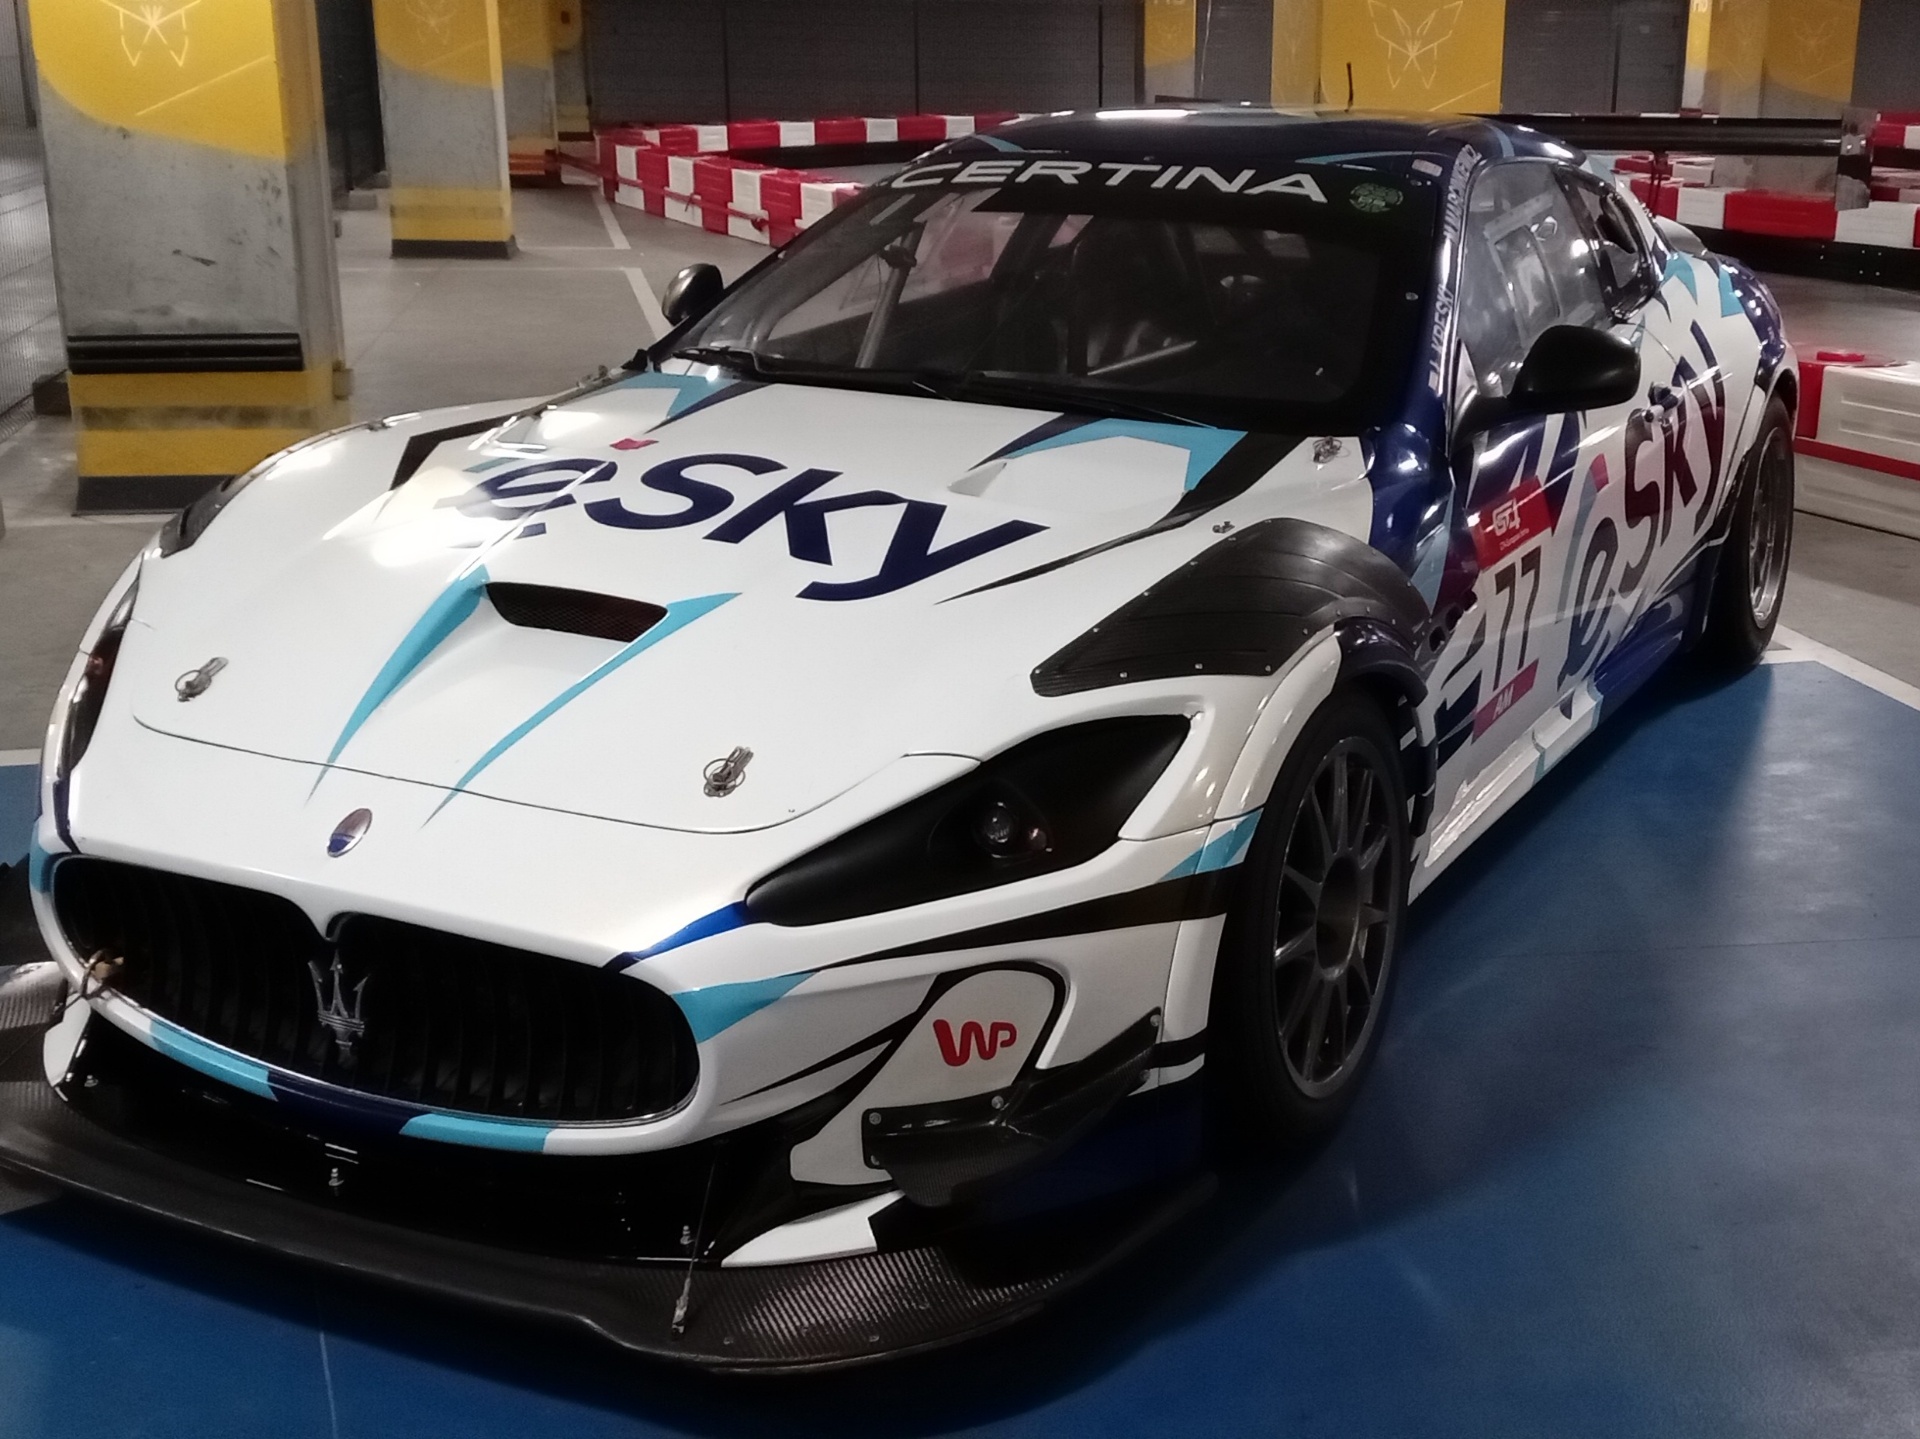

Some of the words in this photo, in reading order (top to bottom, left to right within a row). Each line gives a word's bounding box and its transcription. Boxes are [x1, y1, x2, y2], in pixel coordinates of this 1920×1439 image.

[891, 159, 1328, 204] CERTINA
[1493, 545, 1541, 692] 77
[933, 1019, 1017, 1067] WP
